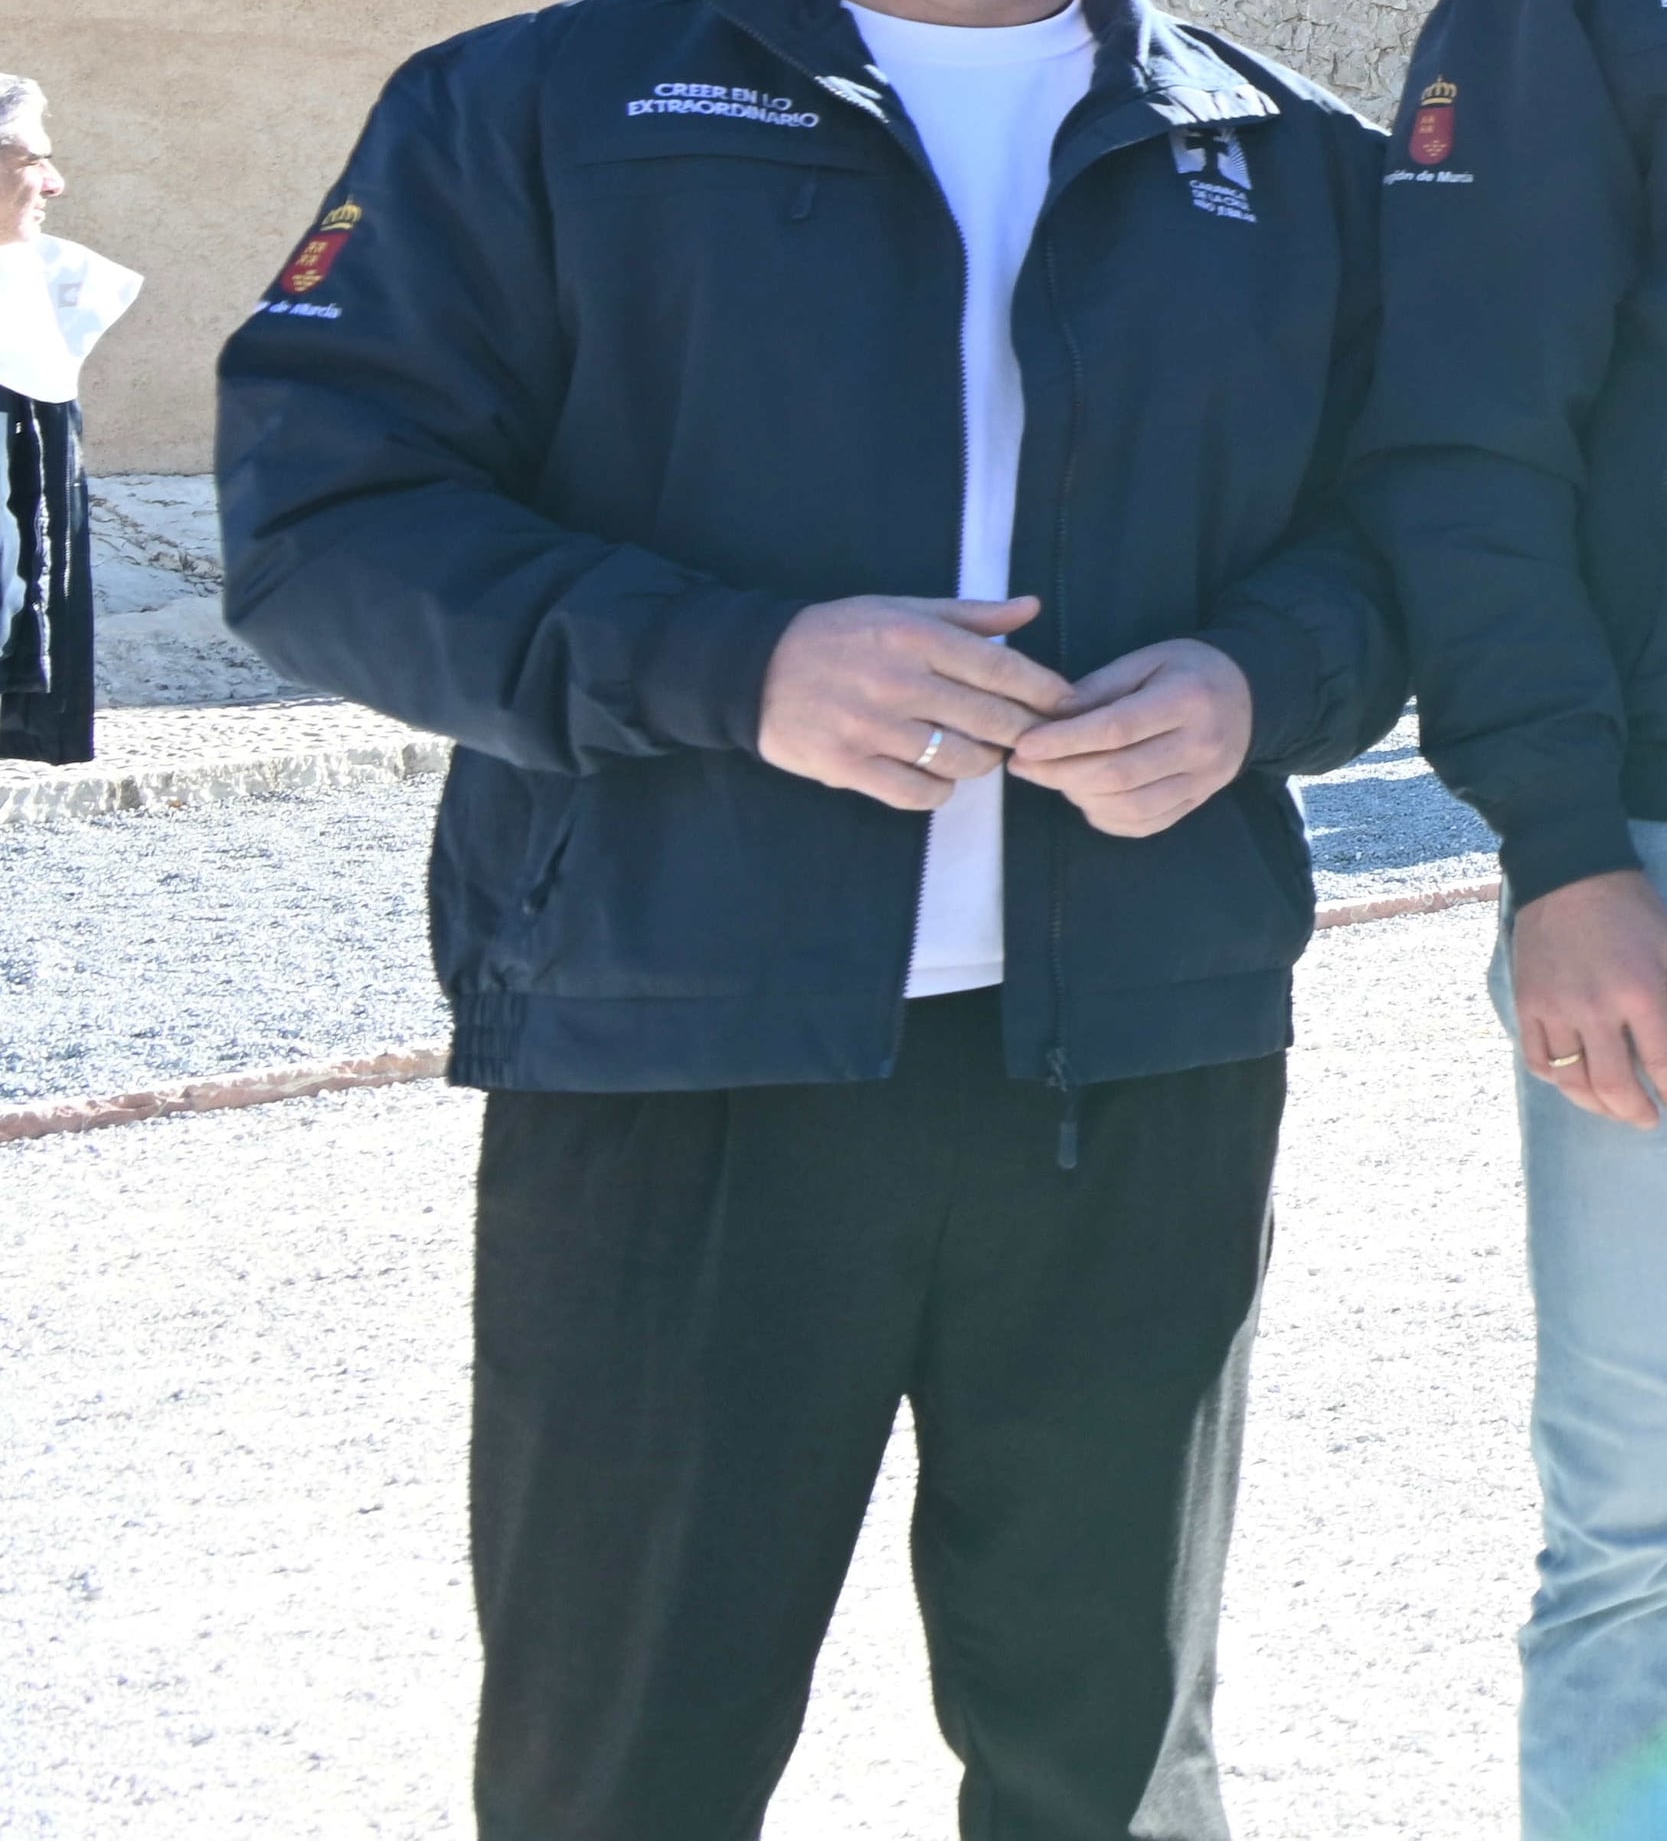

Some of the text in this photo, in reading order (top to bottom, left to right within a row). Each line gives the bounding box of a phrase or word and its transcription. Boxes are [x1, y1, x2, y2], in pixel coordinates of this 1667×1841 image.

[654, 82, 792, 111] CREER EN LO
[627, 99, 820, 128] EXTRAORDINARIO
